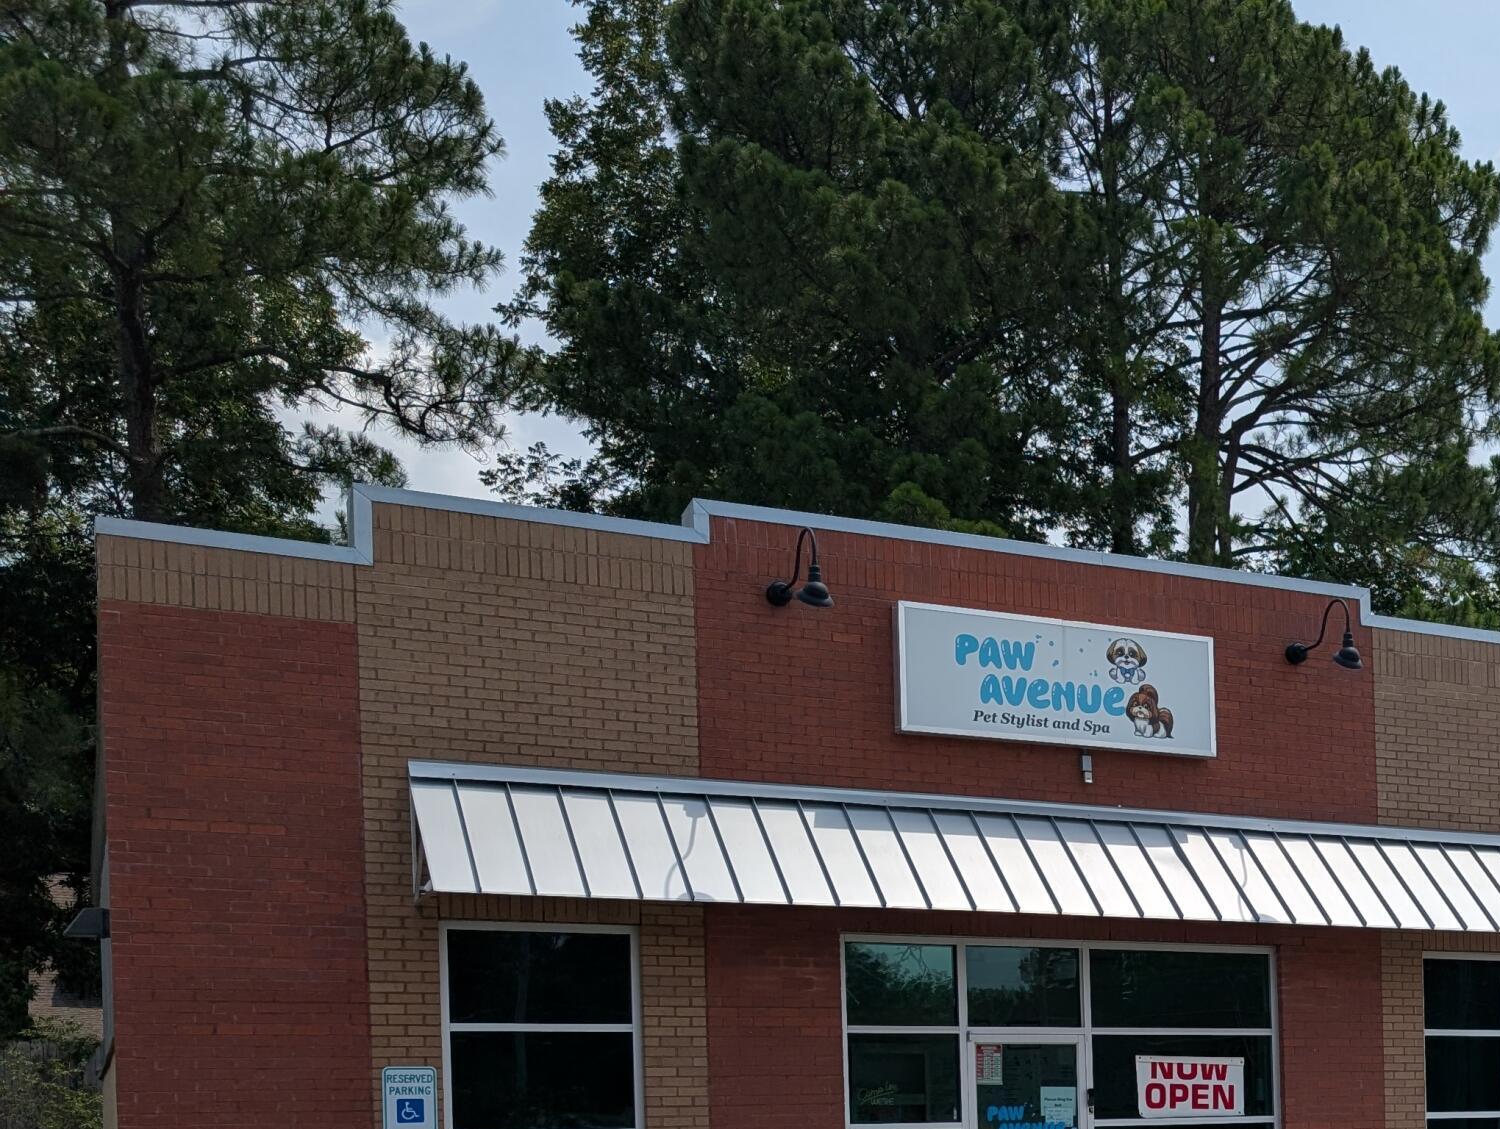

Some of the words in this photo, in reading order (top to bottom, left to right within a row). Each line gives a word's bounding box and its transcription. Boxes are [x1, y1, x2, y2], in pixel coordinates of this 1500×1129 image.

[954, 633, 1036, 672] PAW
[973, 709, 998, 724] Pet
[1000, 712, 1049, 729] Stylist
[1052, 718, 1080, 731] and
[1083, 719, 1110, 735] Spa
[386, 1074, 433, 1084] RESERVED
[388, 1086, 432, 1096] PARKING
[1145, 1082, 1235, 1111] OPEN
[987, 1105, 1025, 1122] PAW
